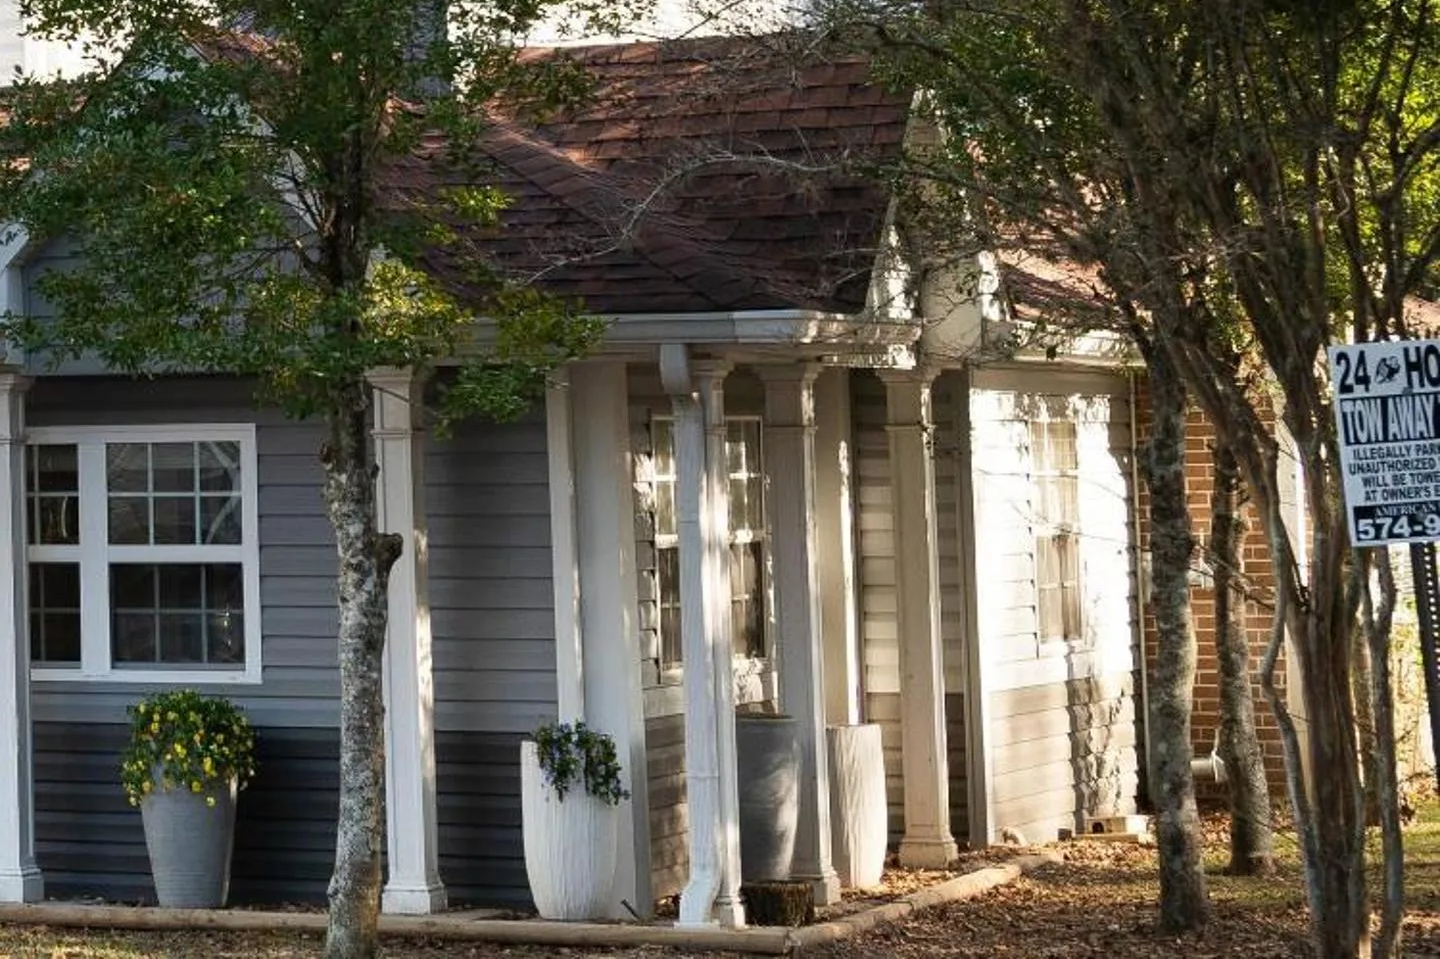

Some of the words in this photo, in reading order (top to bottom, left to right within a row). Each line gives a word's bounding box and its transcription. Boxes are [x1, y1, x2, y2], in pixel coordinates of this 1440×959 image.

[1336, 350, 1371, 394] 24
[1341, 398, 1384, 444] TOW
[1387, 394, 1435, 440] AWAY
[1353, 445, 1411, 460] ILLEGALLY
[1349, 458, 1437, 475] UNAUTHORIZED
[1362, 474, 1389, 488] WILL
[1392, 473, 1407, 485] BE
[1364, 490, 1378, 502] AT
[1381, 486, 1431, 501] OWNER'S
[1375, 504, 1437, 517] AMERICAN
